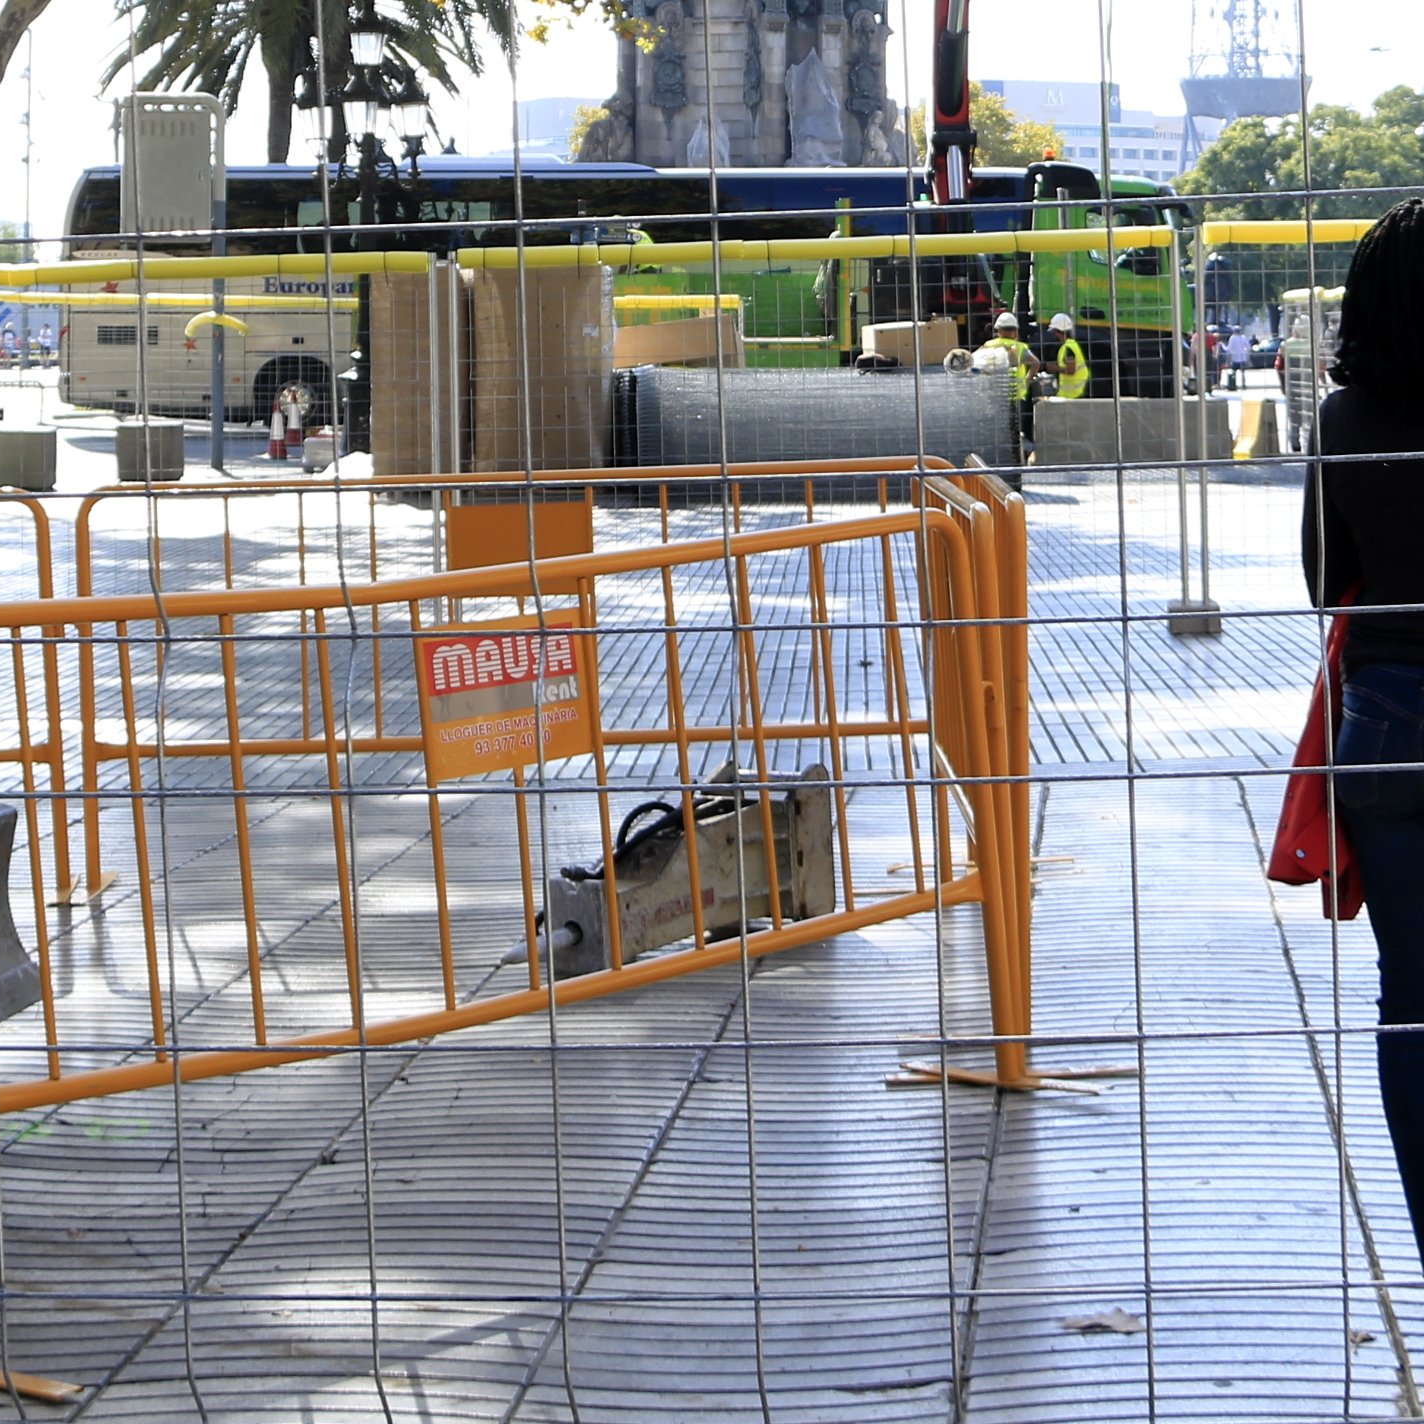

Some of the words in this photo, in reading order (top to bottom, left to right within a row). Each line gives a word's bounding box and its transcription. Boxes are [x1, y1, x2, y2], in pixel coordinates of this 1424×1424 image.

[440, 723, 494, 743] LLOGUER
[496, 719, 512, 732] DE
[513, 707, 579, 730] MAQINÀRIA
[474, 739, 491, 756] 93
[493, 735, 516, 753] 377
[519, 731, 534, 748] 40
